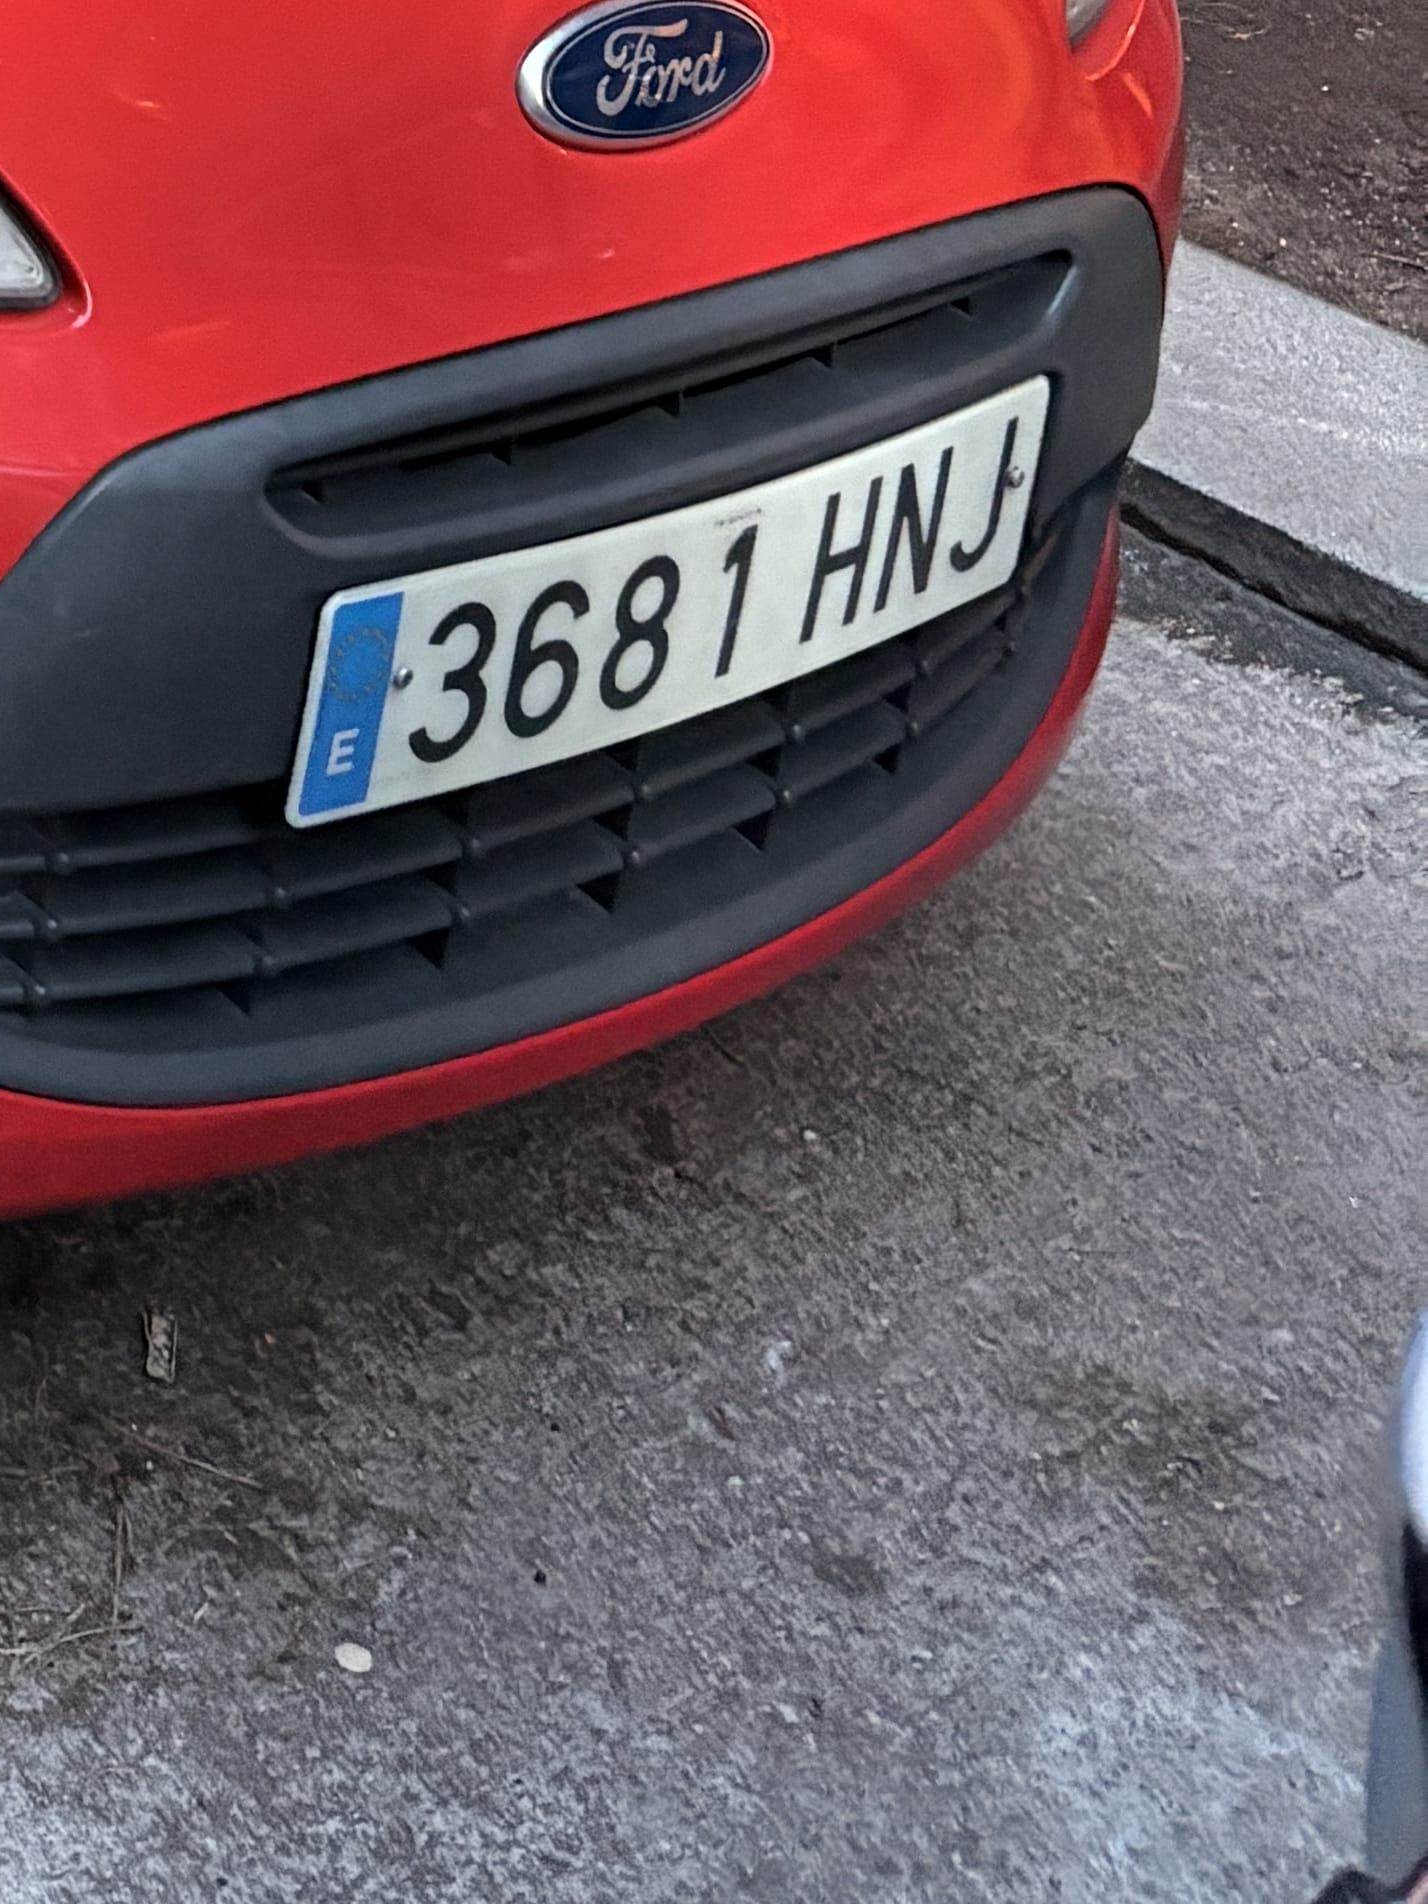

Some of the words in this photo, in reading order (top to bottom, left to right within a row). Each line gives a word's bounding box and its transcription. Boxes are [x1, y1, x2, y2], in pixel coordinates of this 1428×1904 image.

[596, 17, 726, 117] Ford
[406, 523, 760, 764] 3681
[797, 417, 1021, 643] HNJ
[324, 728, 359, 777] E
